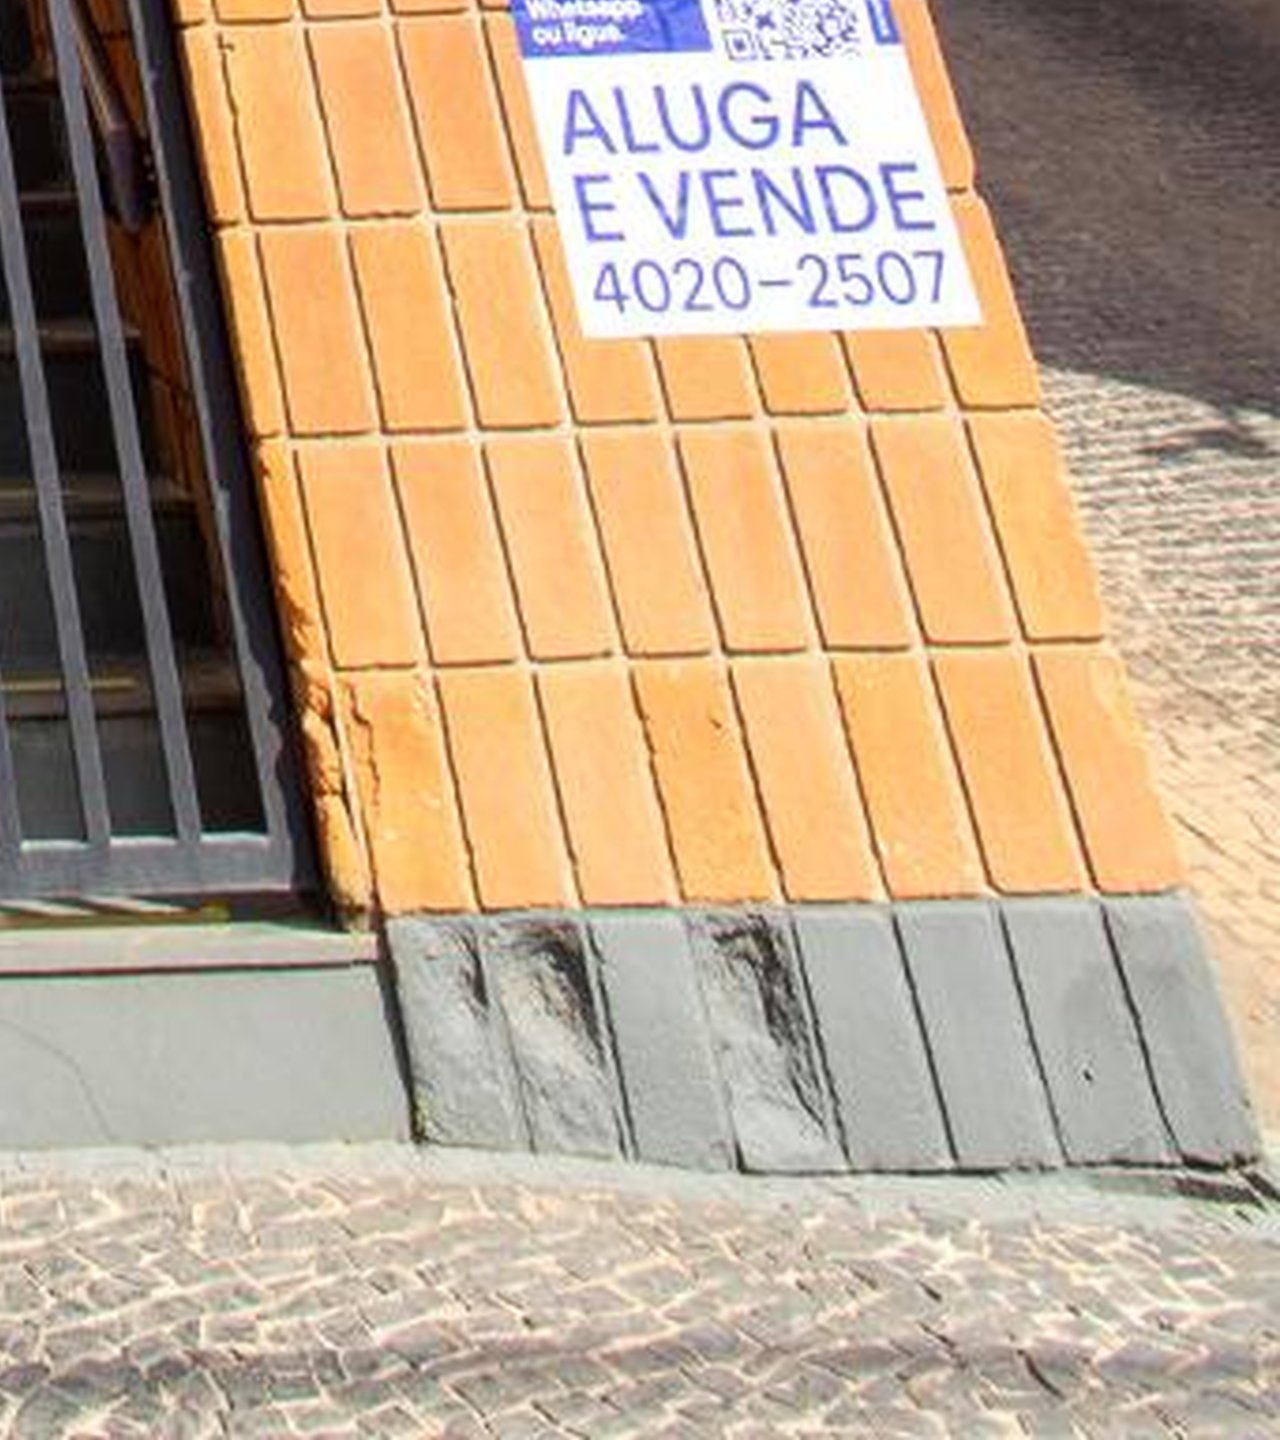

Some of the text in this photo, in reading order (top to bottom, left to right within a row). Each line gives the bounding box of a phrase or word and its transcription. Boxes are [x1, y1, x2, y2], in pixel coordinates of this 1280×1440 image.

[532, 25, 562, 46] ou
[563, 80, 849, 156] ALUGA
[573, 163, 937, 243] E VENDE
[593, 250, 945, 315] 4020-2507
